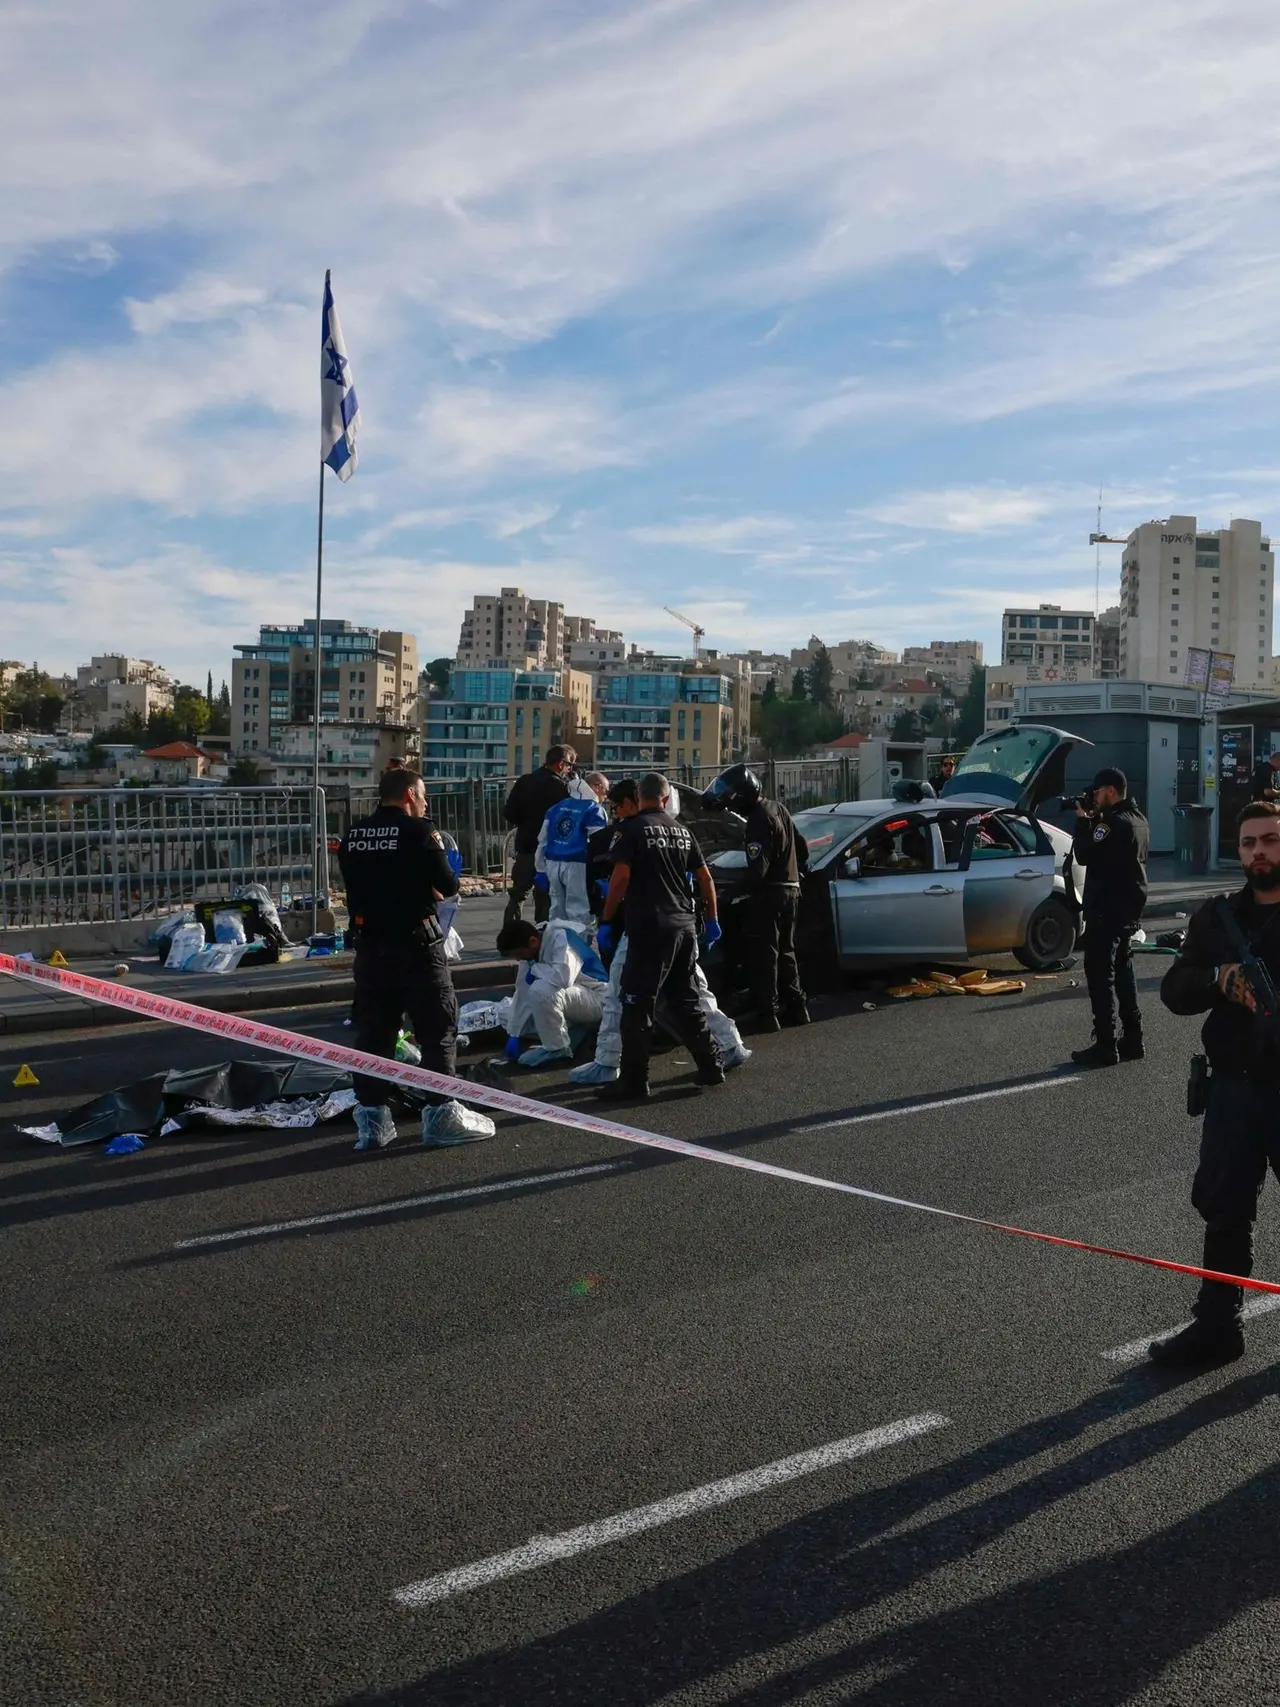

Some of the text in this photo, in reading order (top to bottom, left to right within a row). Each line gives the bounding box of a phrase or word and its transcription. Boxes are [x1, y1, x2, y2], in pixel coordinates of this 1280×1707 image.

[348, 826, 400, 839] משטרה
[644, 825, 691, 838] משטרה
[348, 839, 398, 852] POLICE
[647, 837, 692, 850] POLICE
